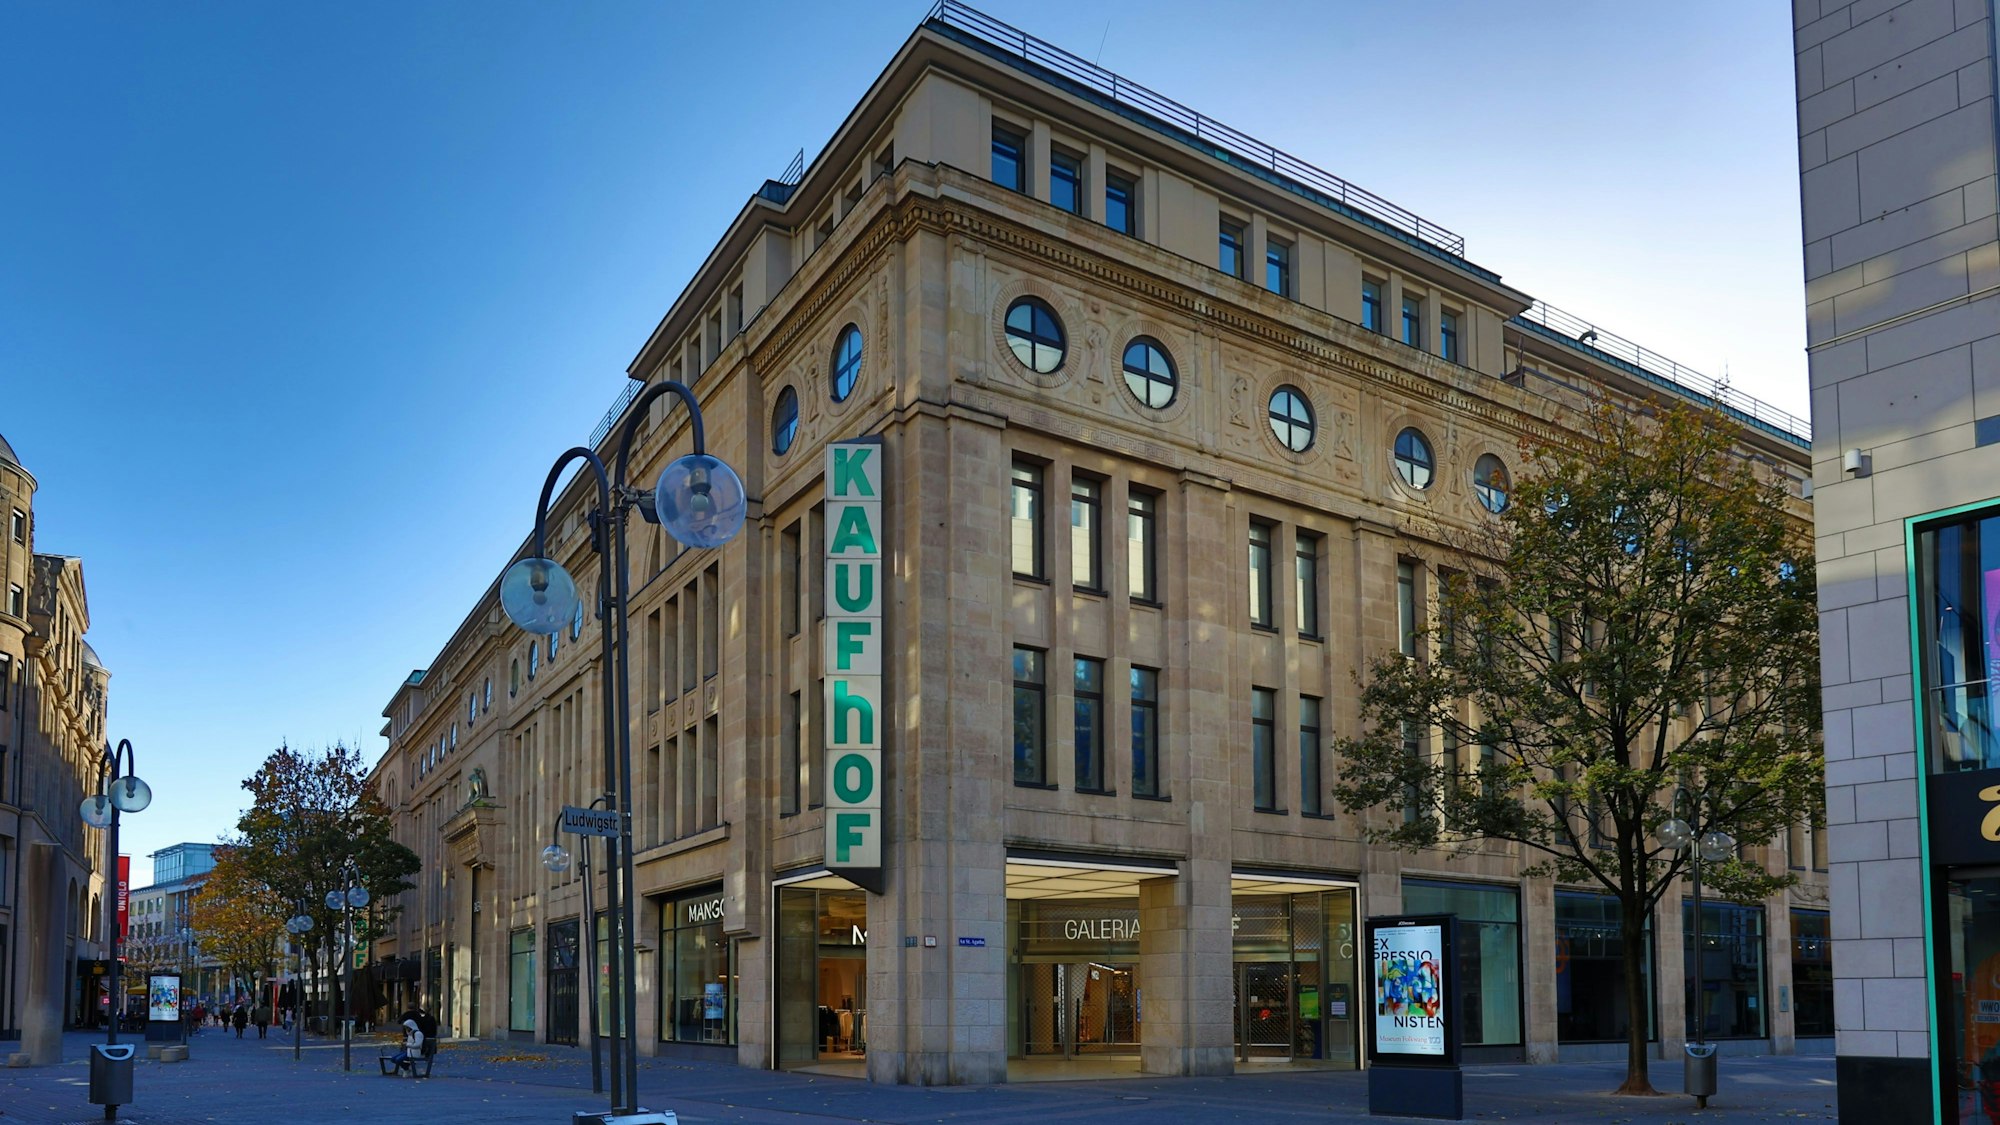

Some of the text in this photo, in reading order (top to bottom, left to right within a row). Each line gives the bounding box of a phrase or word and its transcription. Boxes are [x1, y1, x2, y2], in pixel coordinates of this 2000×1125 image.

[565, 810, 618, 832] Ludwigstr.
[118, 881, 126, 911] UNIQLO
[1065, 919, 1140, 939] GALERIA
[1374, 938, 1389, 950] EX
[1394, 1016, 1445, 1028] NISTEN
